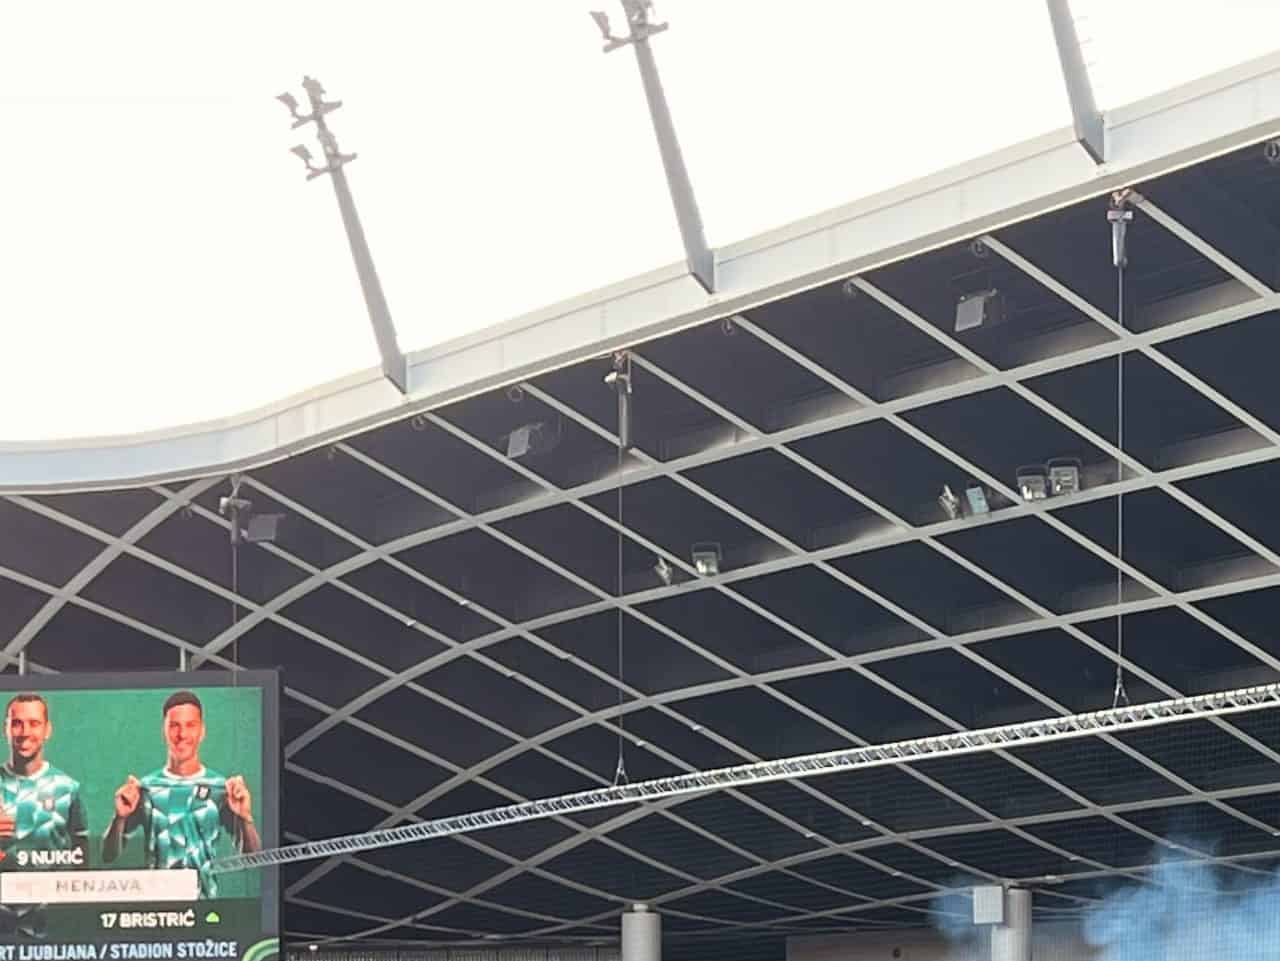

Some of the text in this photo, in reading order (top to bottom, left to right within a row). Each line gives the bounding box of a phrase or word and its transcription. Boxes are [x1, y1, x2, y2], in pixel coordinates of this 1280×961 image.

[17, 847, 83, 866] 9 NUKIĆ
[55, 878, 143, 894] MENJAVA
[100, 909, 195, 928] 17 BRISTRIĆ
[18, 943, 97, 961] LJUBLJANA
[110, 941, 172, 960] STADION
[177, 938, 238, 958] STOŽICE
